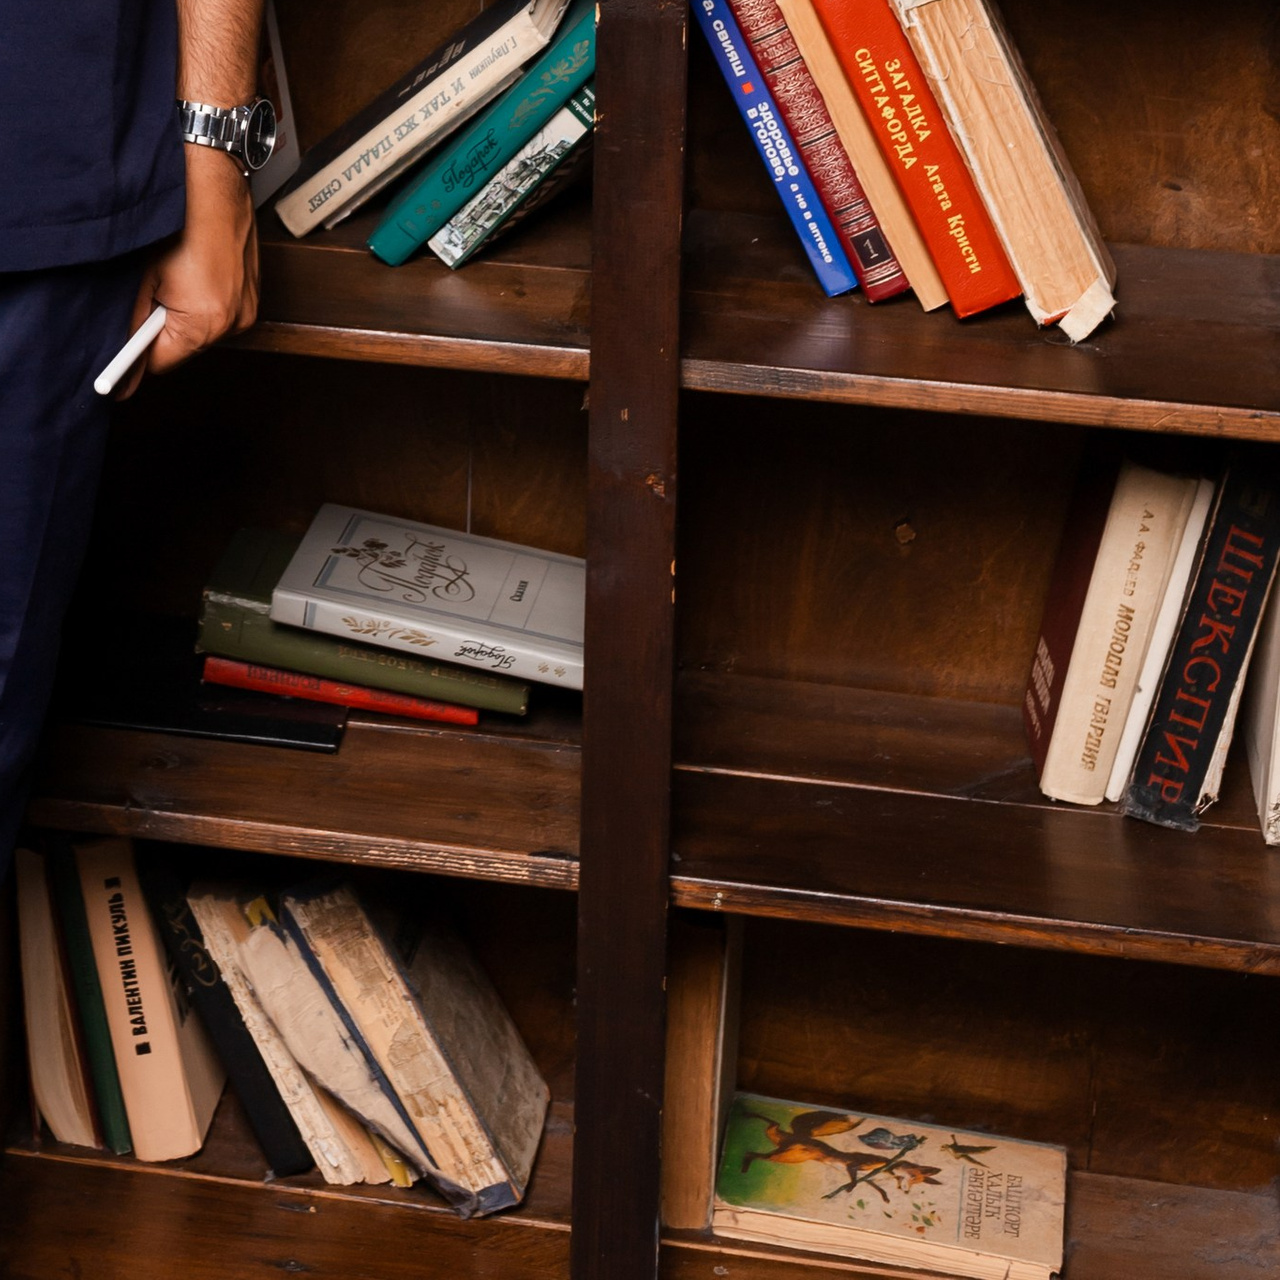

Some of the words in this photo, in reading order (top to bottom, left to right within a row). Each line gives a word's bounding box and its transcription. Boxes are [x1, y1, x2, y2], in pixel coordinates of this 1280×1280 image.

[464, 32, 520, 81] Г.Паушкин
[707, 16, 749, 79] свияш
[416, 87, 453, 121] ТАК
[447, 74, 468, 95] И
[845, 44, 925, 172] СИТТАФОРДА
[879, 54, 938, 145] ЗАГАДКА
[338, 132, 396, 183] ПАДАЛ
[390, 112, 422, 141] ЖЕ
[747, 118, 790, 184] голове,
[753, 98, 803, 179] здоровье
[301, 174, 345, 214] СНЕГ
[434, 122, 511, 203] Подарок
[792, 190, 810, 212] не
[804, 219, 837, 267] аптеке
[918, 158, 958, 213] Агата
[941, 211, 988, 277] Кристи
[358, 533, 475, 603] Подарок
[452, 632, 518, 674] Подарок
[1096, 601, 1138, 690] МОЛОДАЯ
[1140, 522, 1274, 808] ШЕКСПИР
[1076, 693, 1114, 773] ГВАРДИЯ
[105, 888, 134, 957] ПИКУЛЬ
[118, 957, 148, 1037] ВАЛЕНТИН
